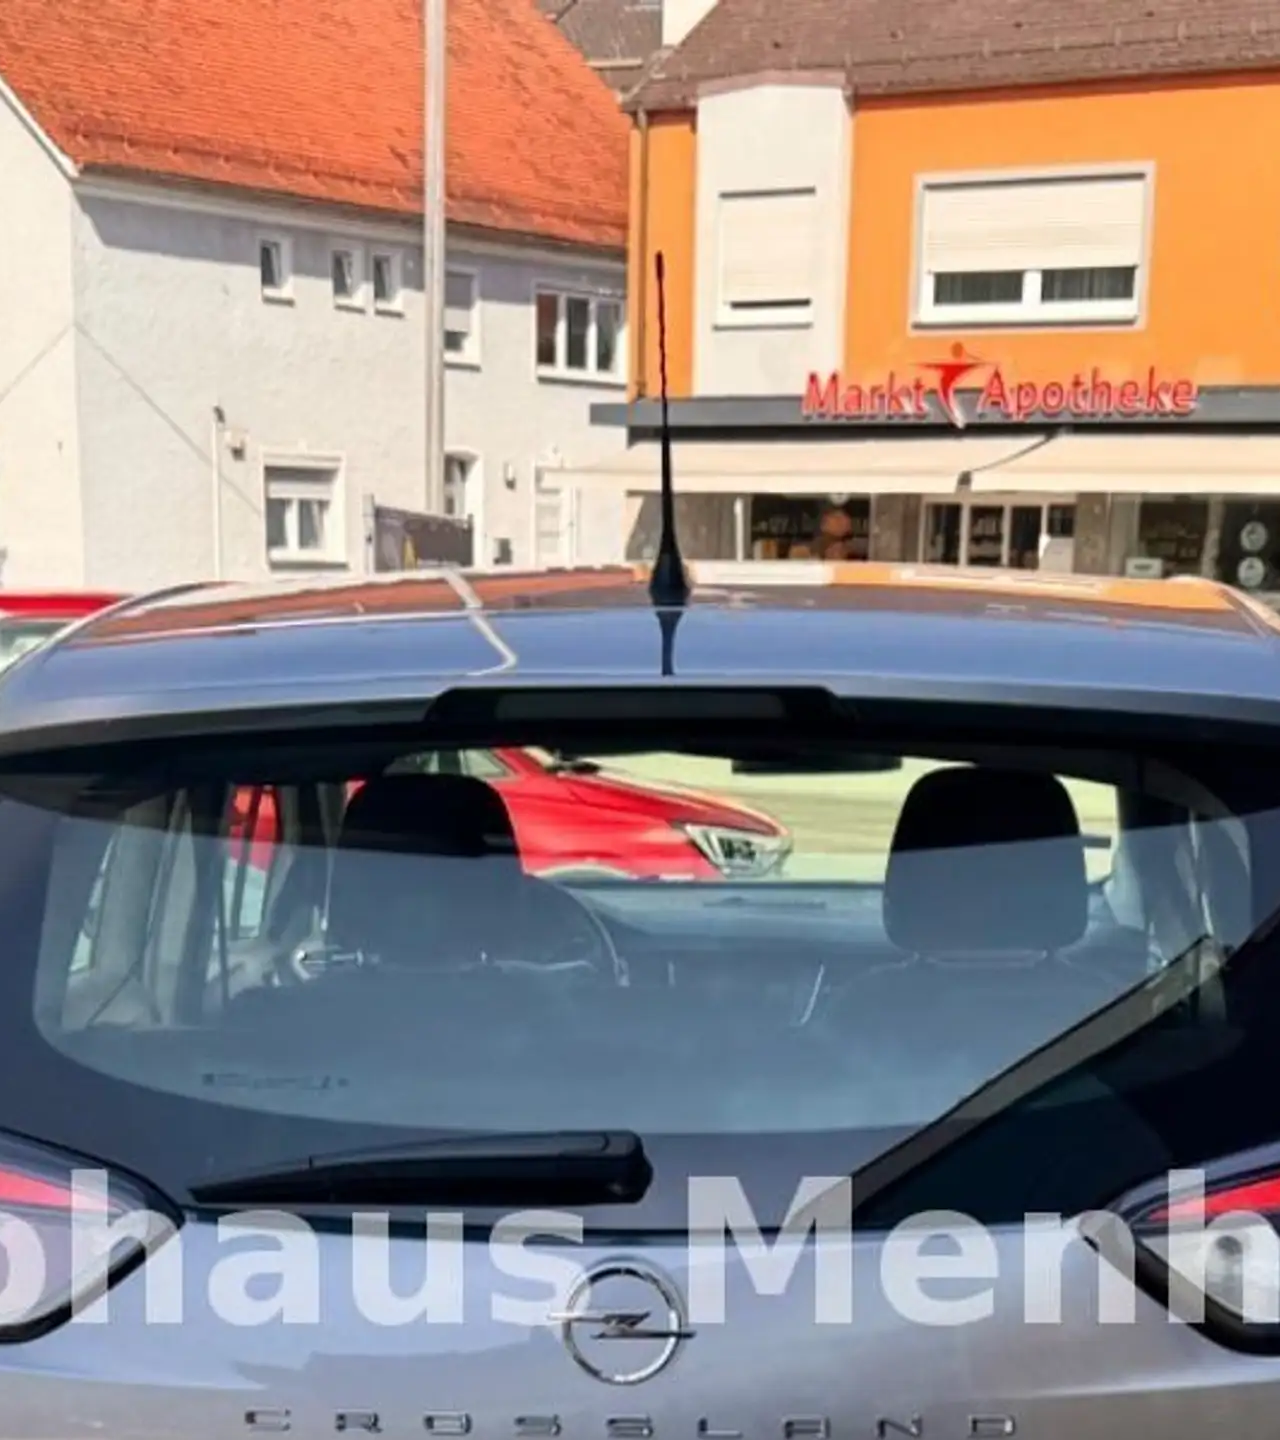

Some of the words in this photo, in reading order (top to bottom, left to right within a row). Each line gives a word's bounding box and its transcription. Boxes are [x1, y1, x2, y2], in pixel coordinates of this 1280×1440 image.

[802, 371, 926, 420] Markt
[978, 366, 1198, 420] Apotheke
[243, 1409, 1016, 1440] CROSSLAND
